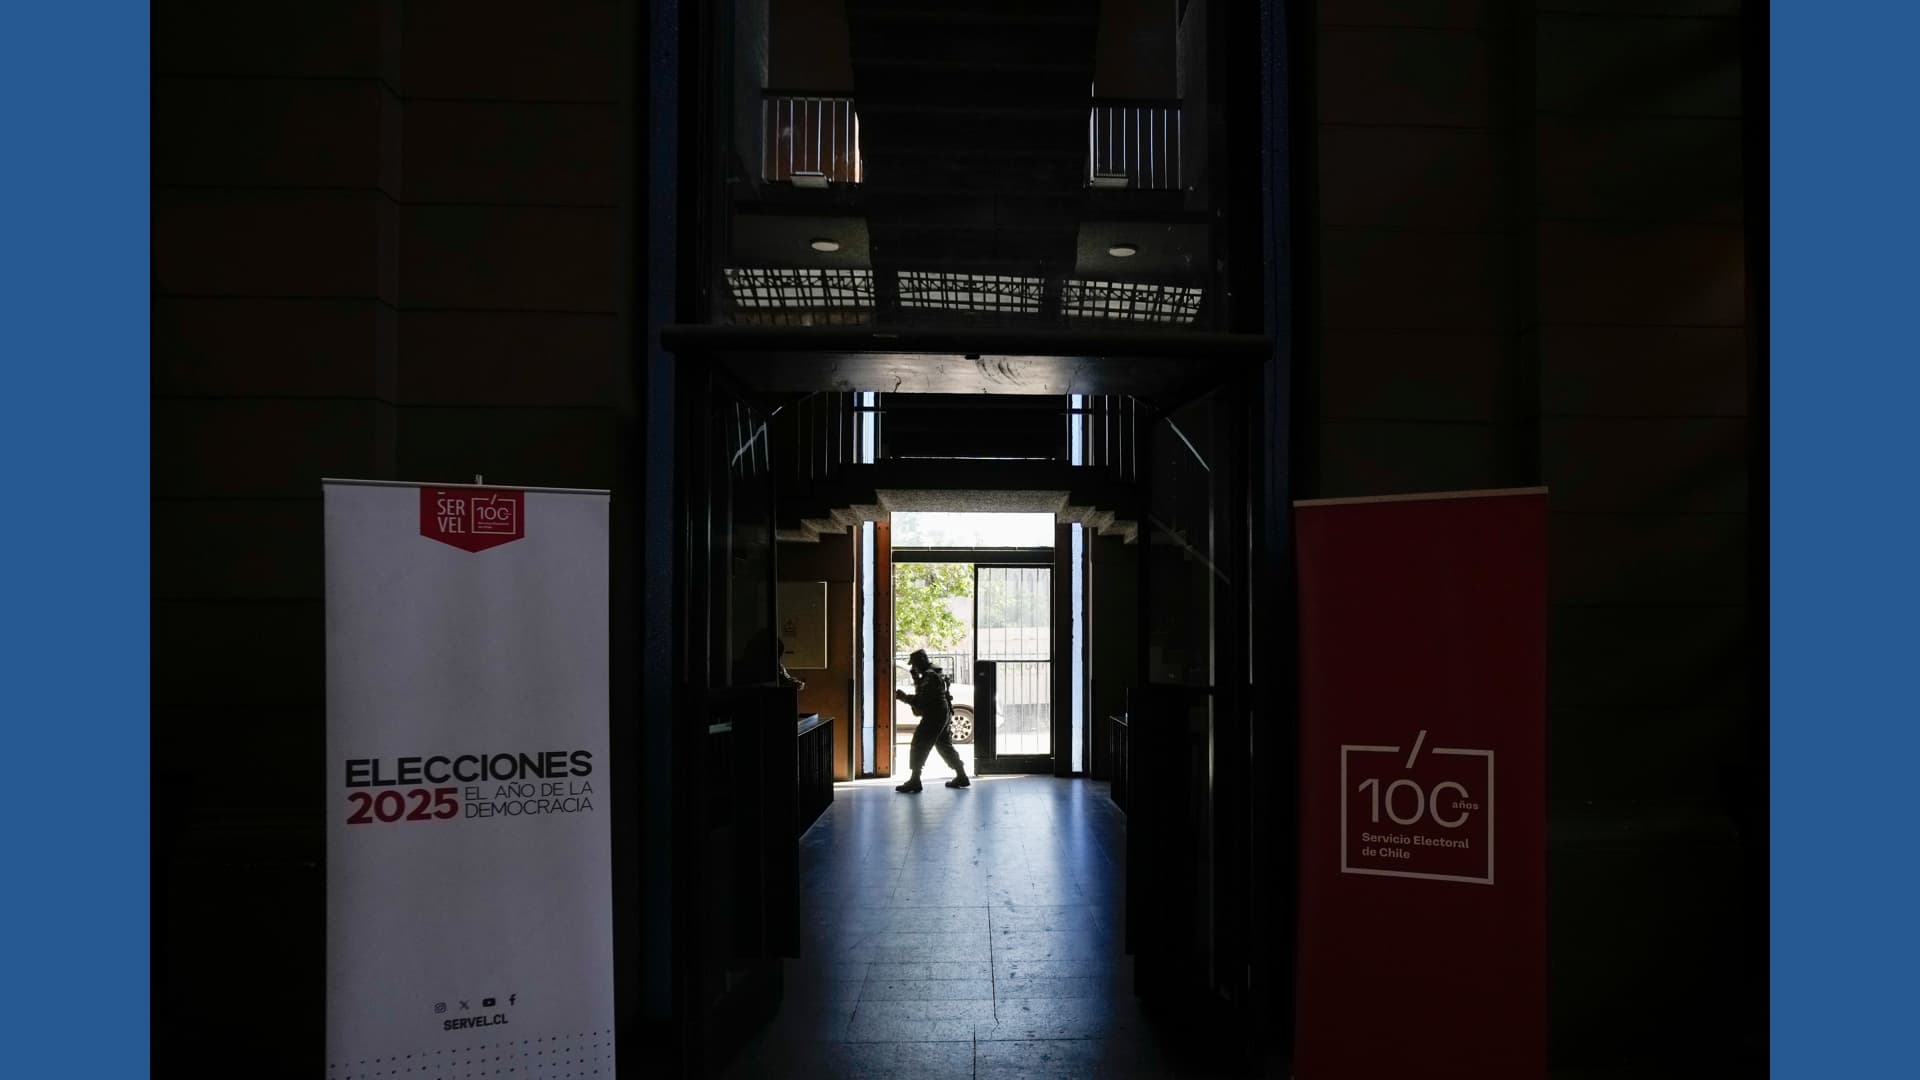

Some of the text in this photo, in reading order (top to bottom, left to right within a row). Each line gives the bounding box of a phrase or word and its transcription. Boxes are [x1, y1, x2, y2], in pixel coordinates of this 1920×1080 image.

[437, 498, 465, 516] SER
[437, 516, 467, 534] VEL
[345, 750, 593, 788] ELECCIONES
[465, 781, 593, 801] EL AÑO DE LA
[346, 787, 459, 825] 2025
[465, 797, 593, 819] DEMOCRACIA
[1451, 801, 1480, 811] años
[1361, 832, 1470, 849] Servicio Electoral
[1361, 846, 1411, 860] de Chile
[443, 1013, 509, 1031] SERVEL.CL
